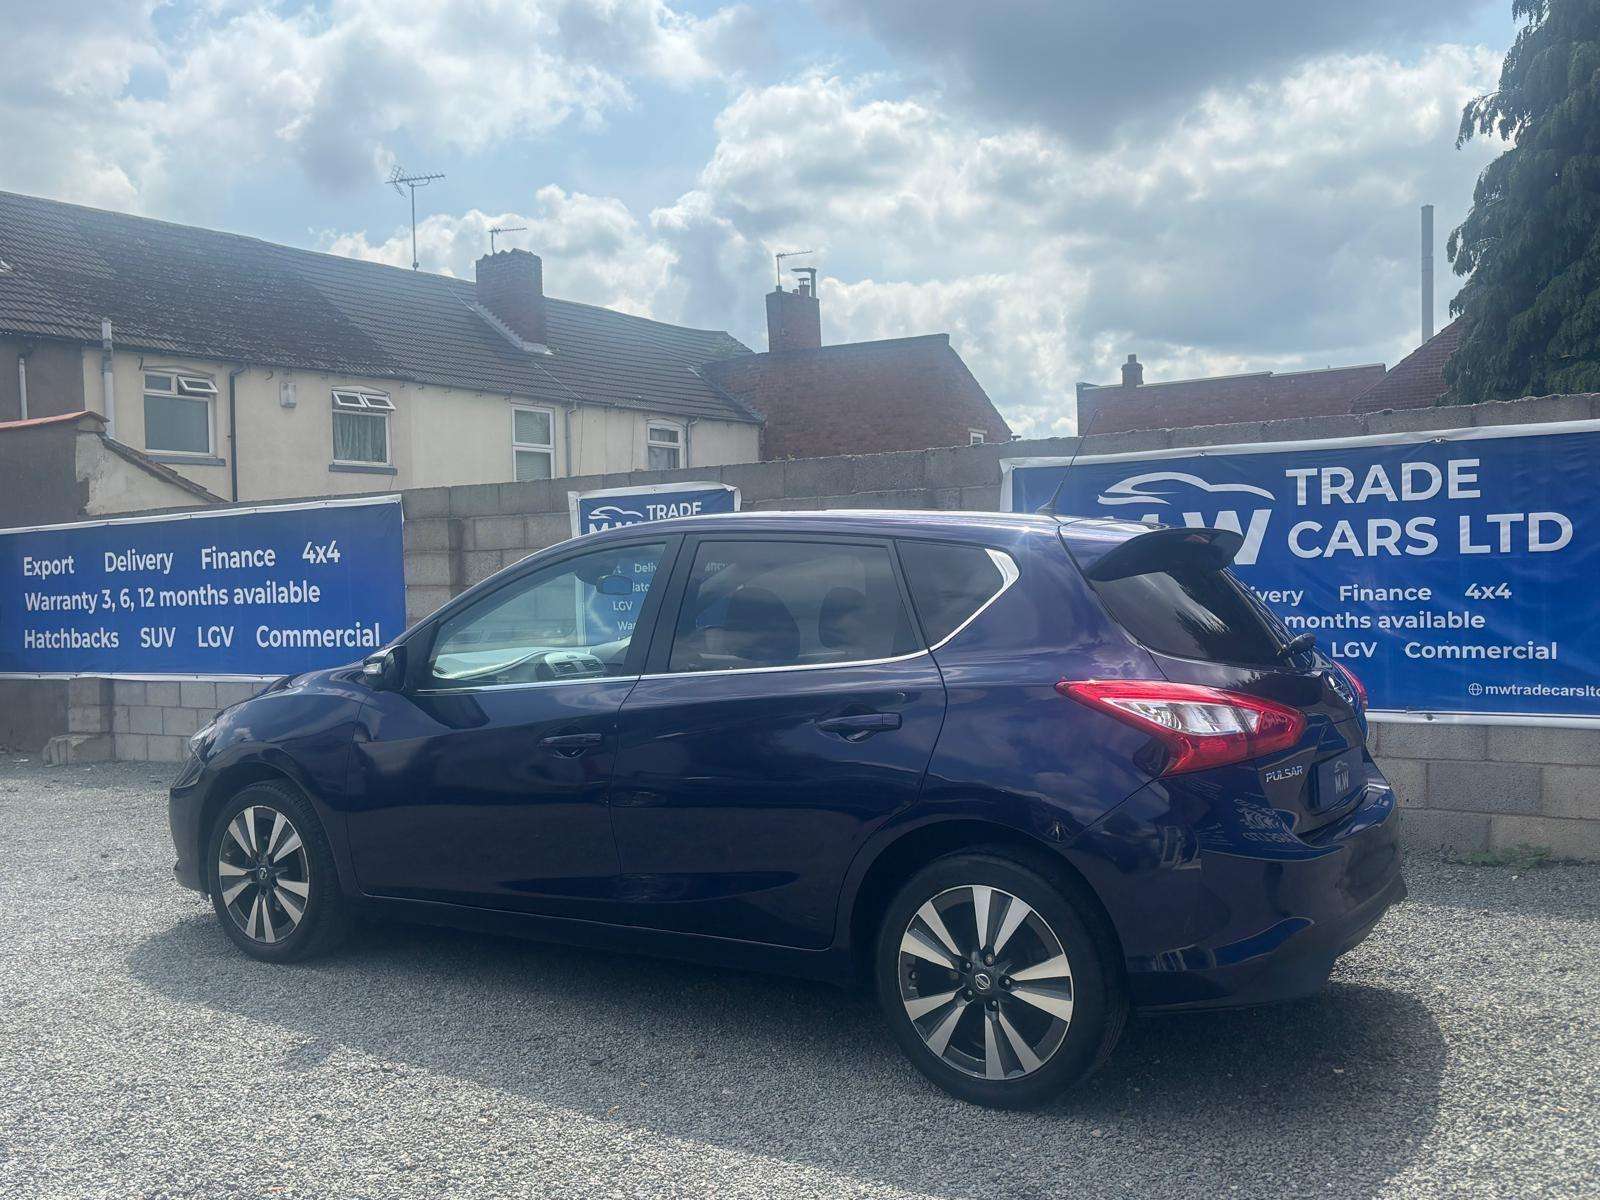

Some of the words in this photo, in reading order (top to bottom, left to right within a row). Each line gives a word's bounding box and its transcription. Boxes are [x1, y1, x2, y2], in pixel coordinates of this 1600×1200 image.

[1286, 458, 1481, 506] TRADE
[646, 501, 702, 520] TRADE
[1287, 516, 1439, 559] CARS
[1459, 511, 1573, 554] LTD
[23, 556, 75, 580] Export
[104, 548, 174, 575] Delivery
[201, 546, 276, 570] Finance
[302, 540, 341, 564] 4x4
[25, 591, 98, 614] Warranty
[101, 589, 116, 612] 3,
[119, 588, 135, 611] 6,
[138, 587, 155, 608] 12
[160, 584, 229, 607] months
[233, 579, 321, 604] available
[1339, 584, 1432, 601] Finance
[1464, 582, 1512, 600] 4x4
[612, 600, 633, 611] LGV
[1284, 611, 1372, 629] months
[1377, 610, 1486, 629] available
[24, 627, 120, 649] Hatchbacks
[140, 626, 176, 648] SUV
[197, 625, 235, 648] LGV
[256, 621, 380, 648] Commercial
[1331, 641, 1378, 658] LGV
[1404, 641, 1557, 660] Commercial
[1265, 765, 1303, 783] PULSAR
